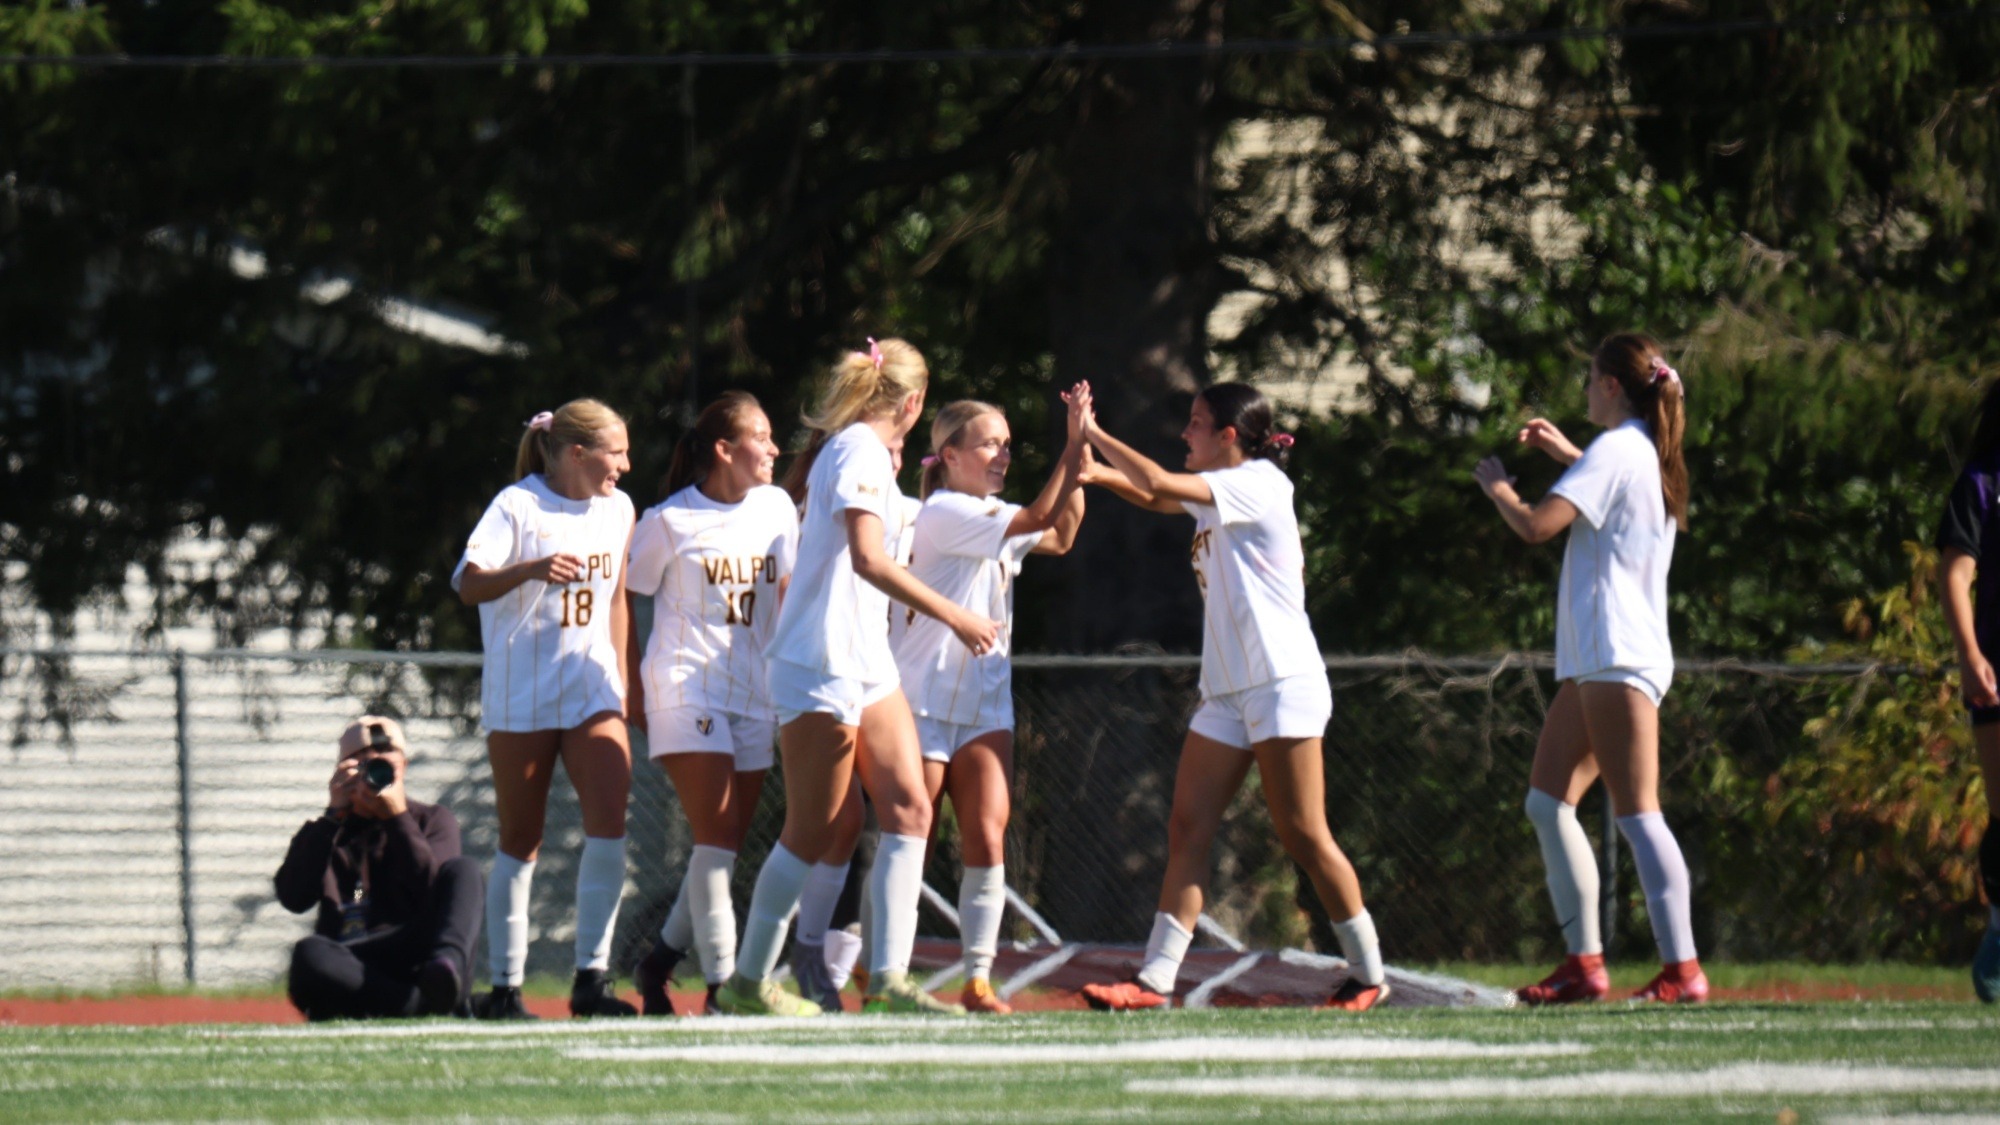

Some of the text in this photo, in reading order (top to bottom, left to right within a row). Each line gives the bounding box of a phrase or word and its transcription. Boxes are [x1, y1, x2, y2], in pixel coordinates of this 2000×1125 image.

[703, 555, 777, 585] VALPO
[560, 589, 593, 628] 18
[726, 590, 756, 627] 10
